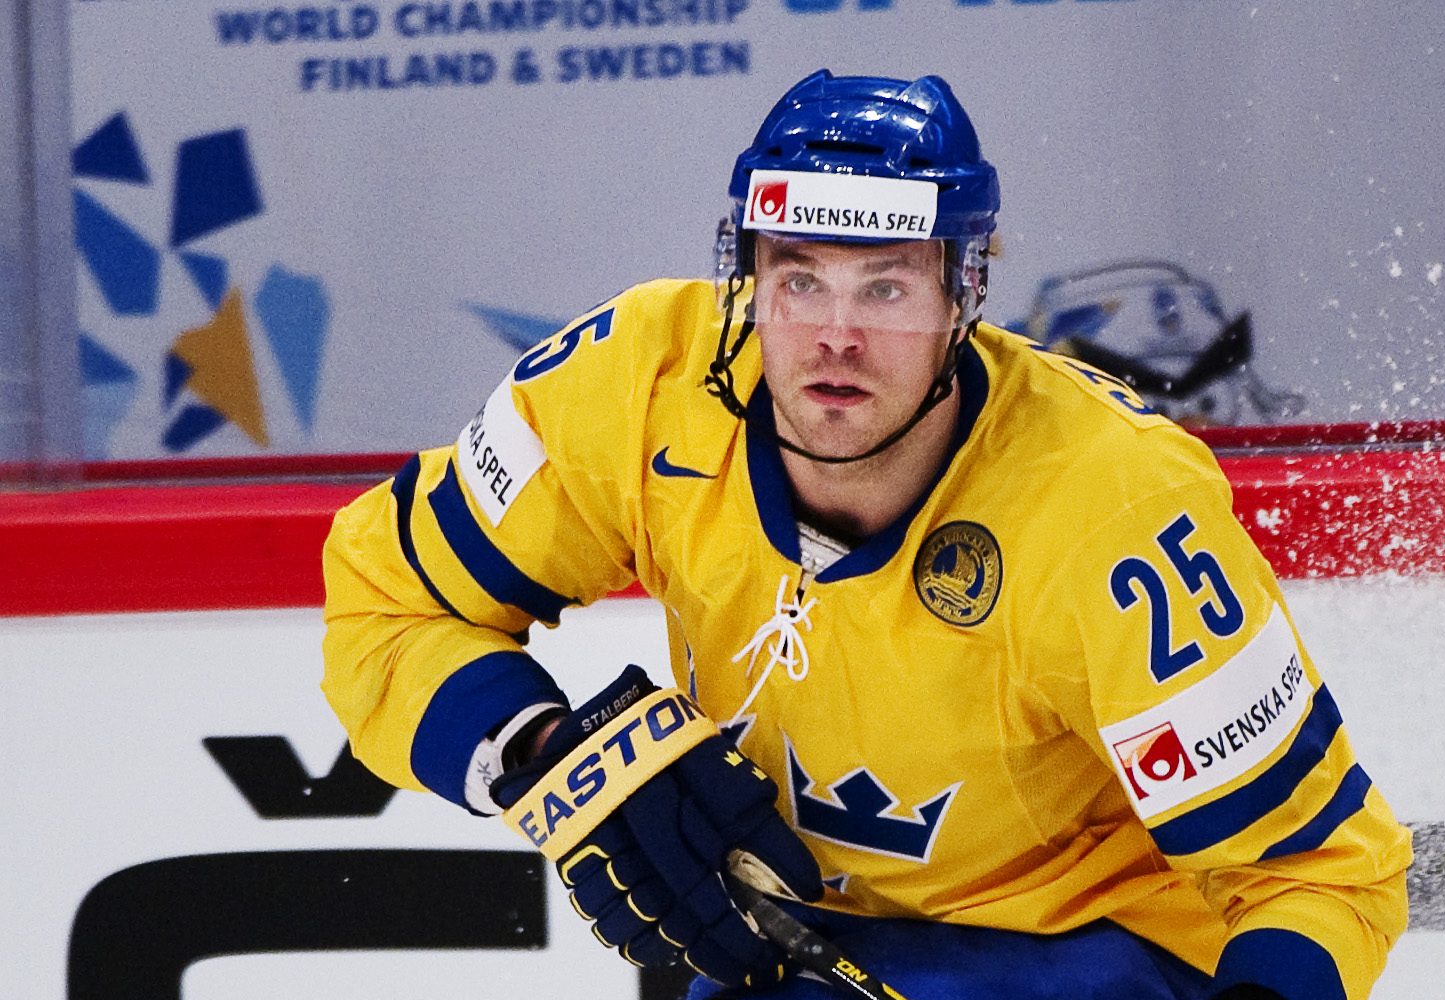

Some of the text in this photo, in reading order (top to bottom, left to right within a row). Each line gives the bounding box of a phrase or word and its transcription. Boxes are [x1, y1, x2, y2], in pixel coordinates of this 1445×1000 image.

[215, 10, 379, 45] WORLD
[397, 0, 748, 38] CHAMPIONSHIP
[300, 41, 750, 91] FINLAND & SWEDEN
[792, 206, 927, 233] SVENSKA SPEL
[476, 446, 513, 506] SPEL
[1108, 510, 1246, 685] 25
[581, 684, 641, 733] STALBERG
[1194, 653, 1303, 768] SVENSKA SPEL
[518, 694, 709, 848] EASTON
